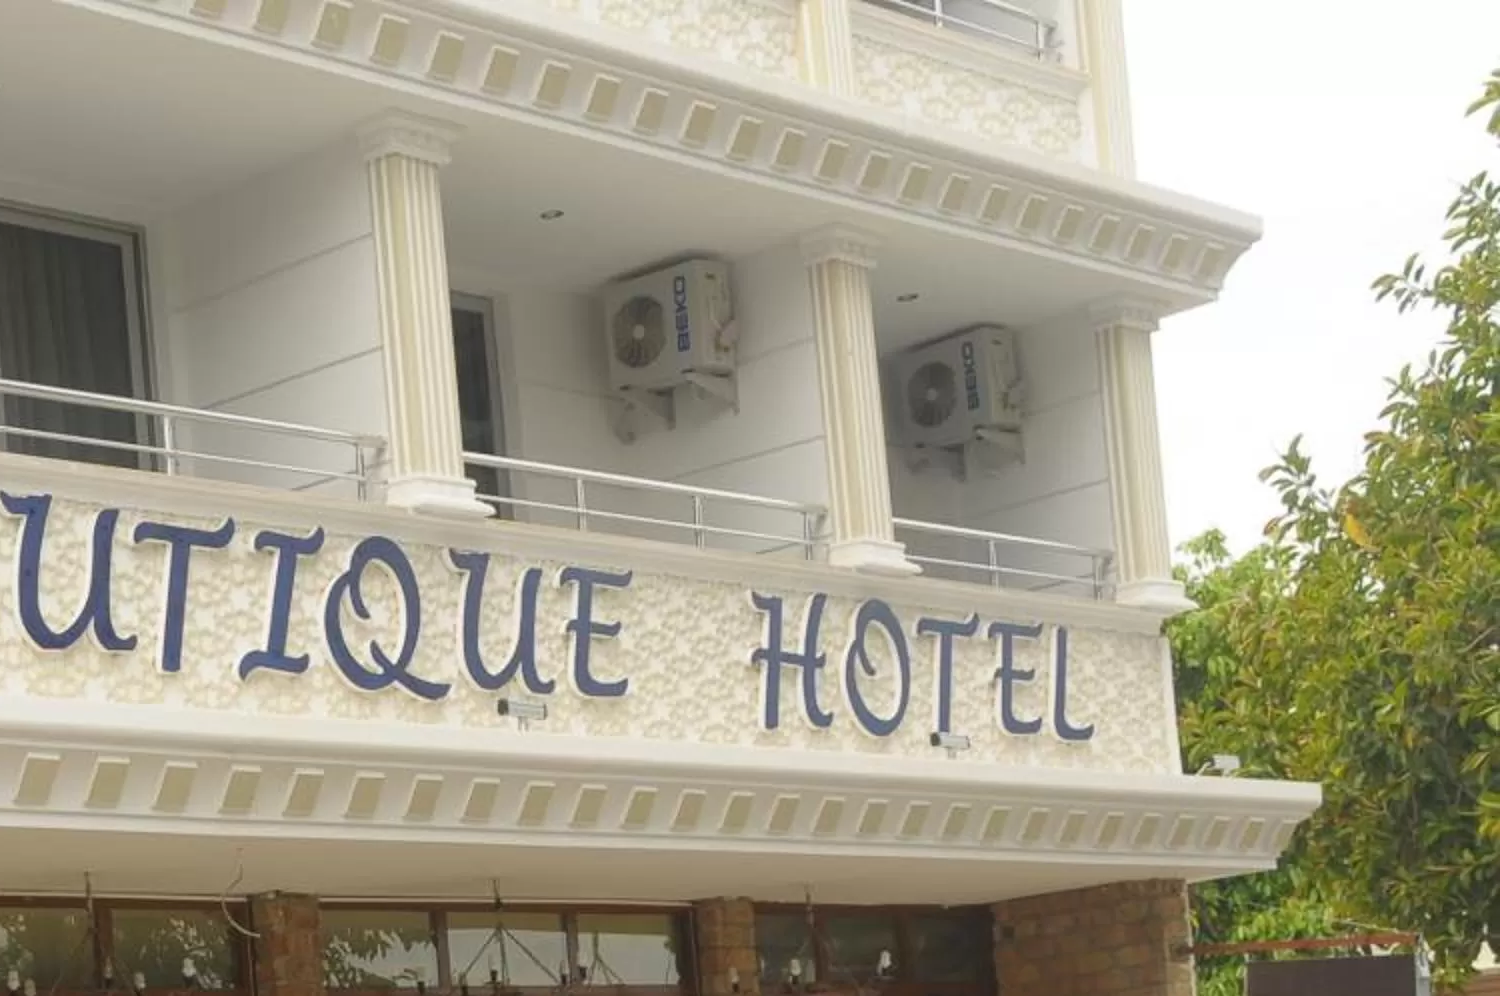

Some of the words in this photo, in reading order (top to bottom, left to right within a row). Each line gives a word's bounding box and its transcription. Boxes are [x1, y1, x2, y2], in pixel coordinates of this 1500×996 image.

[673, 275, 690, 353] BEKO
[962, 341, 980, 410] BEKO
[751, 593, 1095, 740] HOTEL
